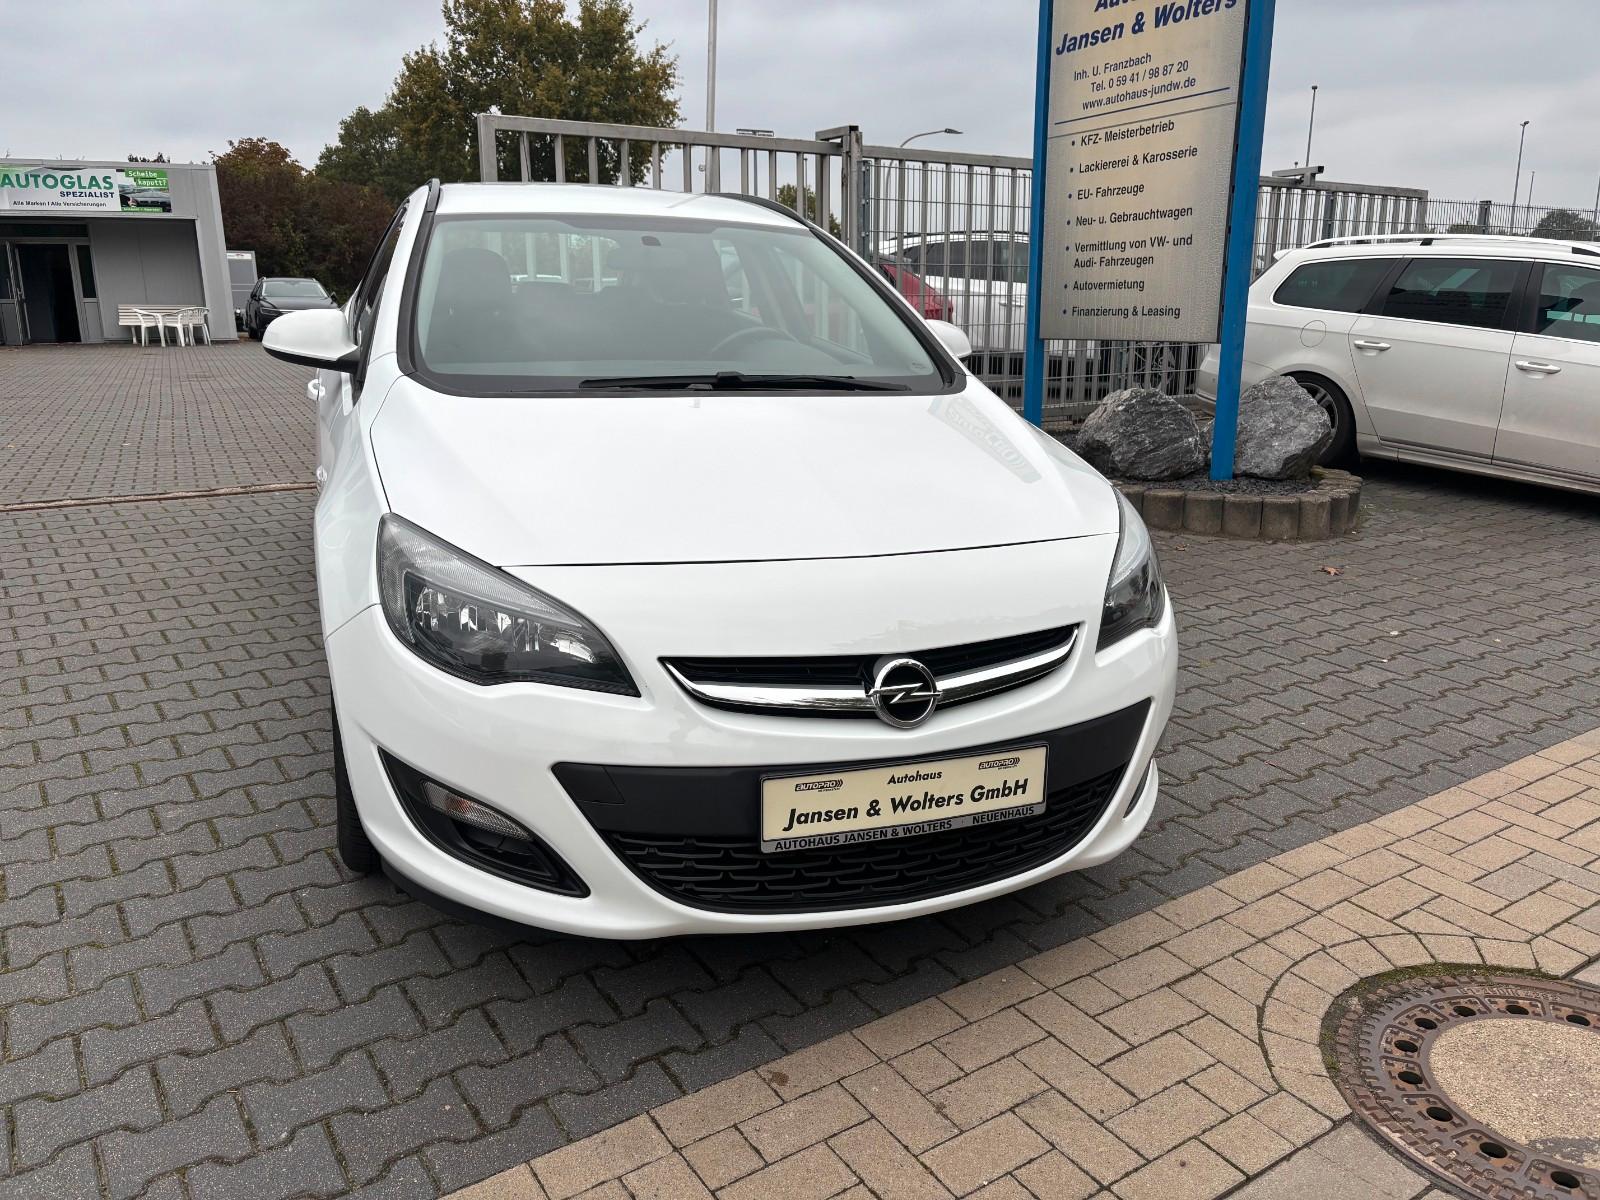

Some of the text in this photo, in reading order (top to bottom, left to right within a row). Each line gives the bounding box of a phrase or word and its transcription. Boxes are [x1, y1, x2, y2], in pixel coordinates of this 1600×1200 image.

[1056, 22, 1124, 55] Jansen
[1131, 11, 1146, 35] &
[1073, 52, 1152, 81] Inh. U. Franzbach
[1091, 79, 1106, 92] Tel.
[1108, 78, 1114, 89] 0
[1116, 75, 1127, 87] 59
[1129, 72, 1139, 84] 41
[1148, 66, 1160, 80] 98
[1162, 63, 1174, 77] 87
[1177, 60, 1189, 73] 20
[1082, 77, 1196, 111] www.autohaus-jundw.de
[1080, 119, 1175, 147] KFZ- Meisterbetrieb
[1079, 145, 1198, 174] Lackiererei & Karosserie
[0, 173, 114, 190] AUTOGLAS
[59, 191, 115, 199] SPEZIALIST
[1077, 183, 1145, 201] EU- Fahrzeuge
[1075, 207, 1193, 227] Neu- u. Gebrauchtwagen
[1074, 234, 1193, 253] Vermittlung von VW- und
[1073, 254, 1154, 269] Audi- Fahrzeugen
[1072, 279, 1145, 292] Autovermietung
[1071, 306, 1181, 319] Finanzierung & Leasing
[887, 769, 942, 785] Autohaus
[782, 778, 1029, 832] Jansen & Wolters GmbH
[775, 806, 1035, 851] AUTOHAUS JANSEN & WOLTERS NEUENHAUS
